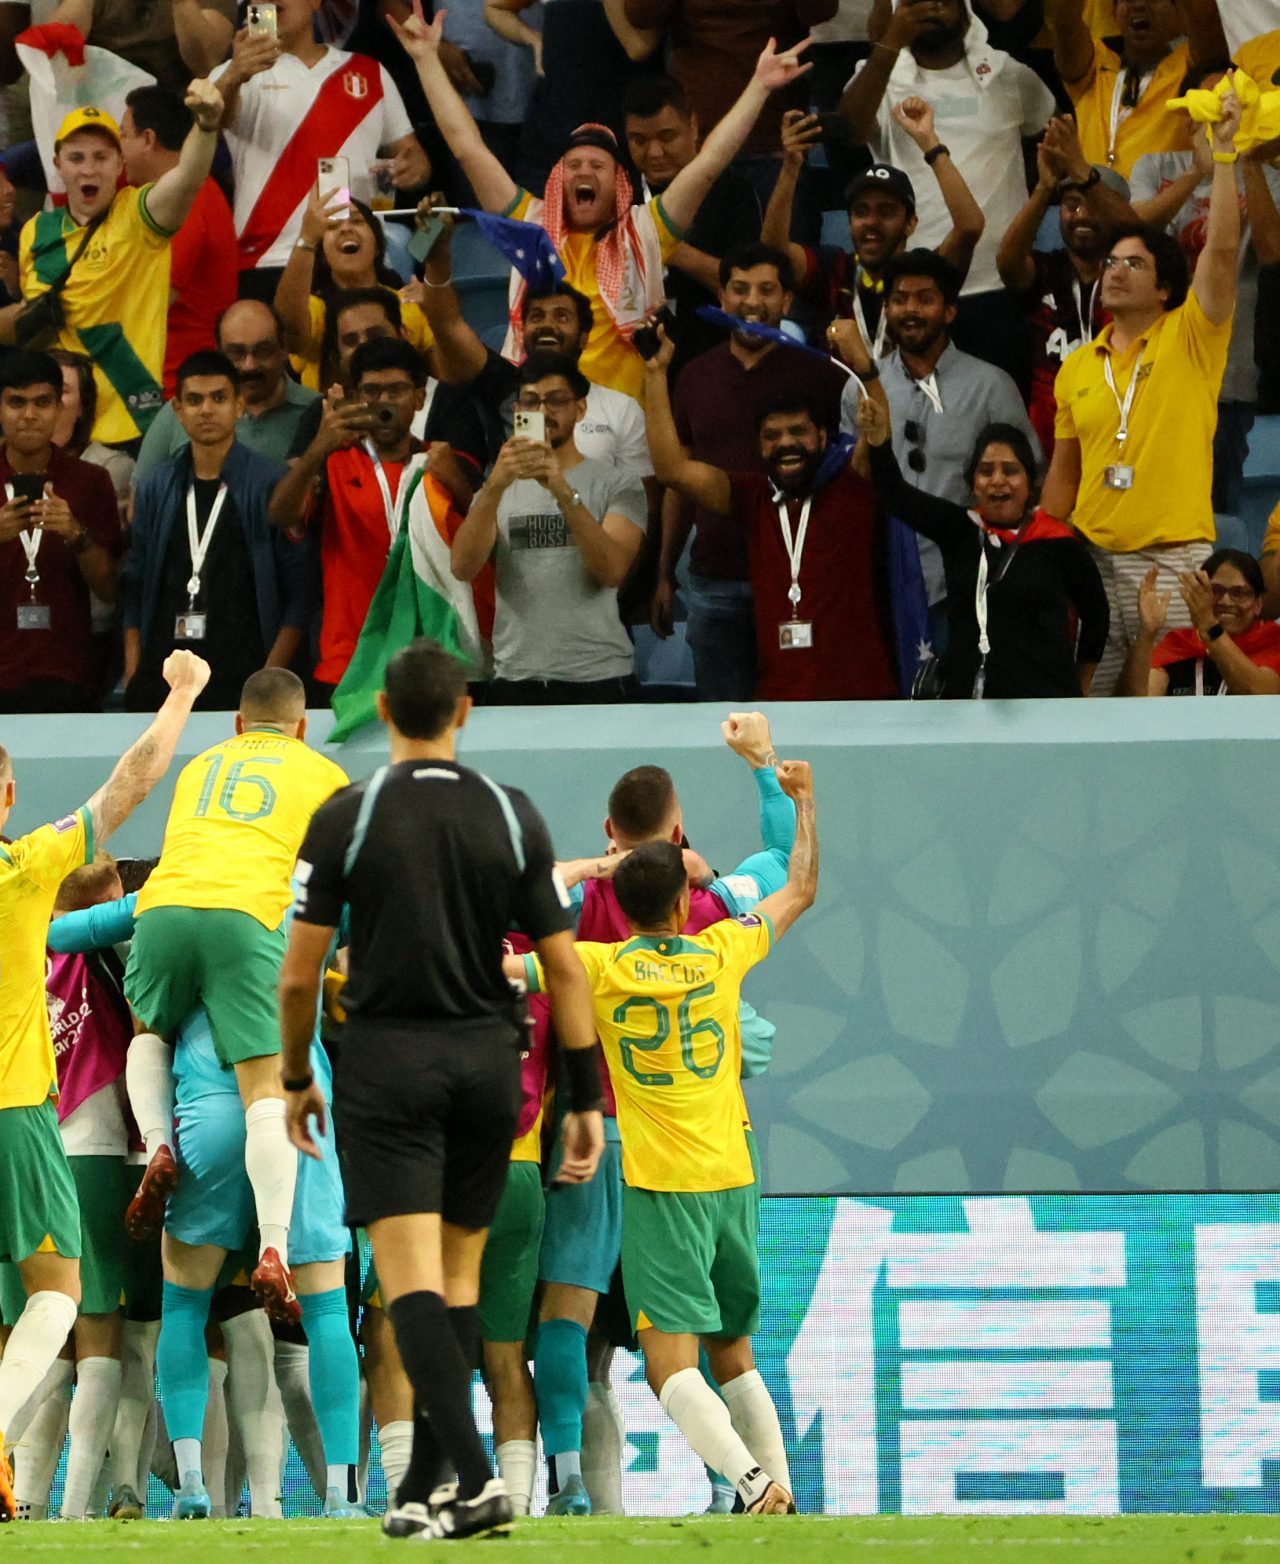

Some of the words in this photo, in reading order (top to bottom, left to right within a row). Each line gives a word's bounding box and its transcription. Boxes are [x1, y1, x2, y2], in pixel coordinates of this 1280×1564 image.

[527, 514, 565, 531] HUGO
[528, 532, 564, 549] BOSS
[193, 753, 283, 822] 16
[634, 960, 706, 984] BACCUS
[612, 981, 725, 1086] 26
